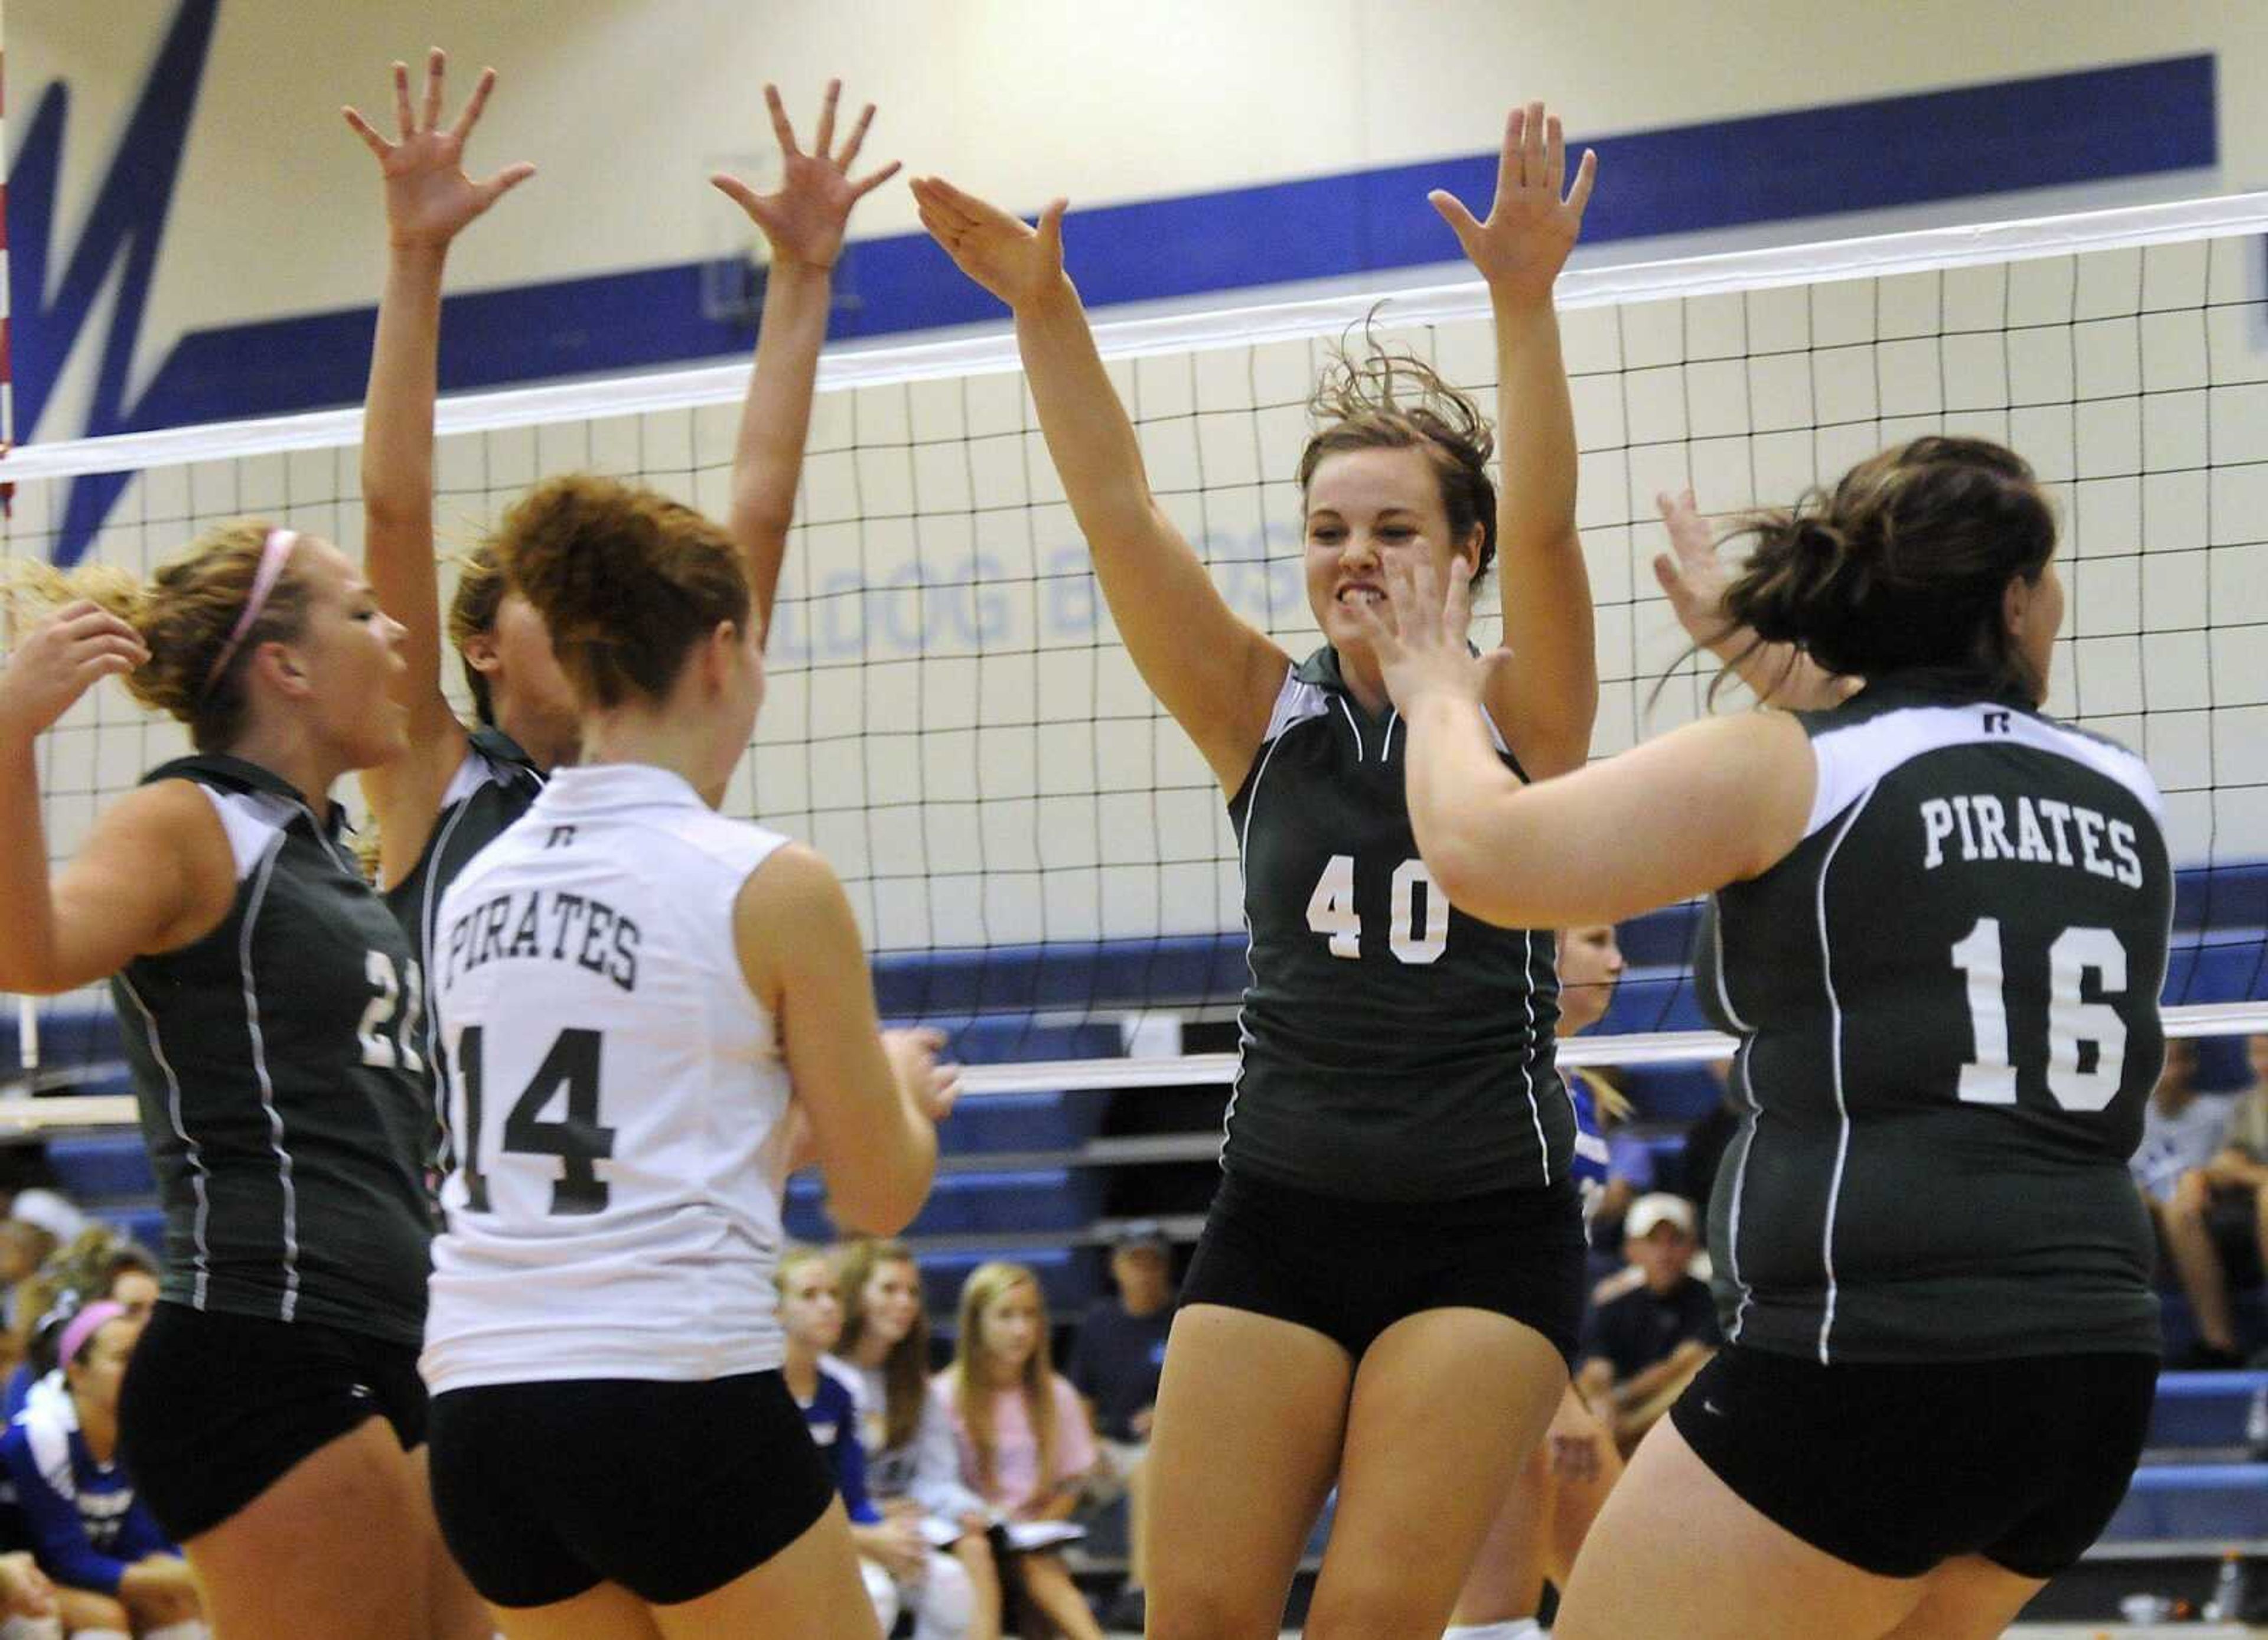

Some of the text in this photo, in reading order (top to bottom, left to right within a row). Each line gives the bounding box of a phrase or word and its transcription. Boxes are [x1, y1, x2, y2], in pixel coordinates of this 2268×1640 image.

[1920, 794, 2143, 889] PIRATES
[445, 891, 641, 992] PIRATES
[1305, 854, 1450, 964] 40
[1951, 917, 2127, 1111] 16
[458, 1025, 617, 1216] 14
